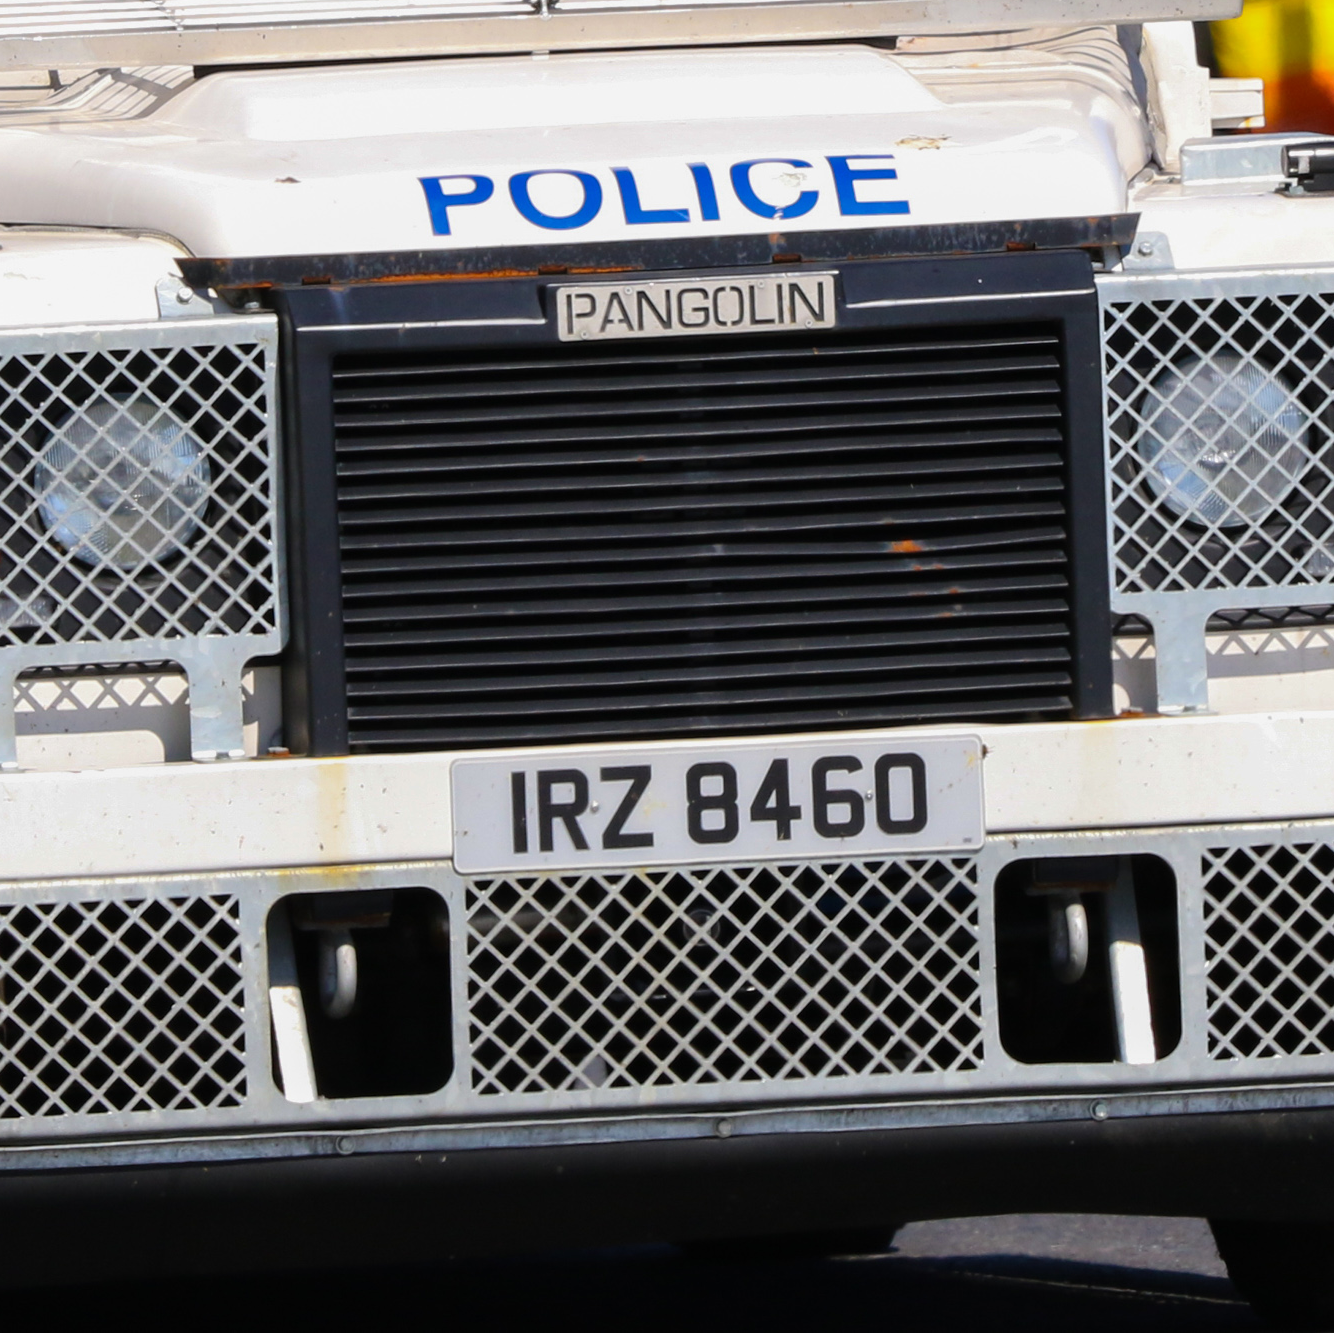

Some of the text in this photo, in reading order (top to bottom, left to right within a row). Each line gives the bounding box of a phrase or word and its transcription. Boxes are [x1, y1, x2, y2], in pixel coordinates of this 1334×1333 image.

[417, 154, 910, 237] POLICE
[566, 280, 826, 336] PANGOLIN
[510, 751, 929, 854] IRZ 8460
